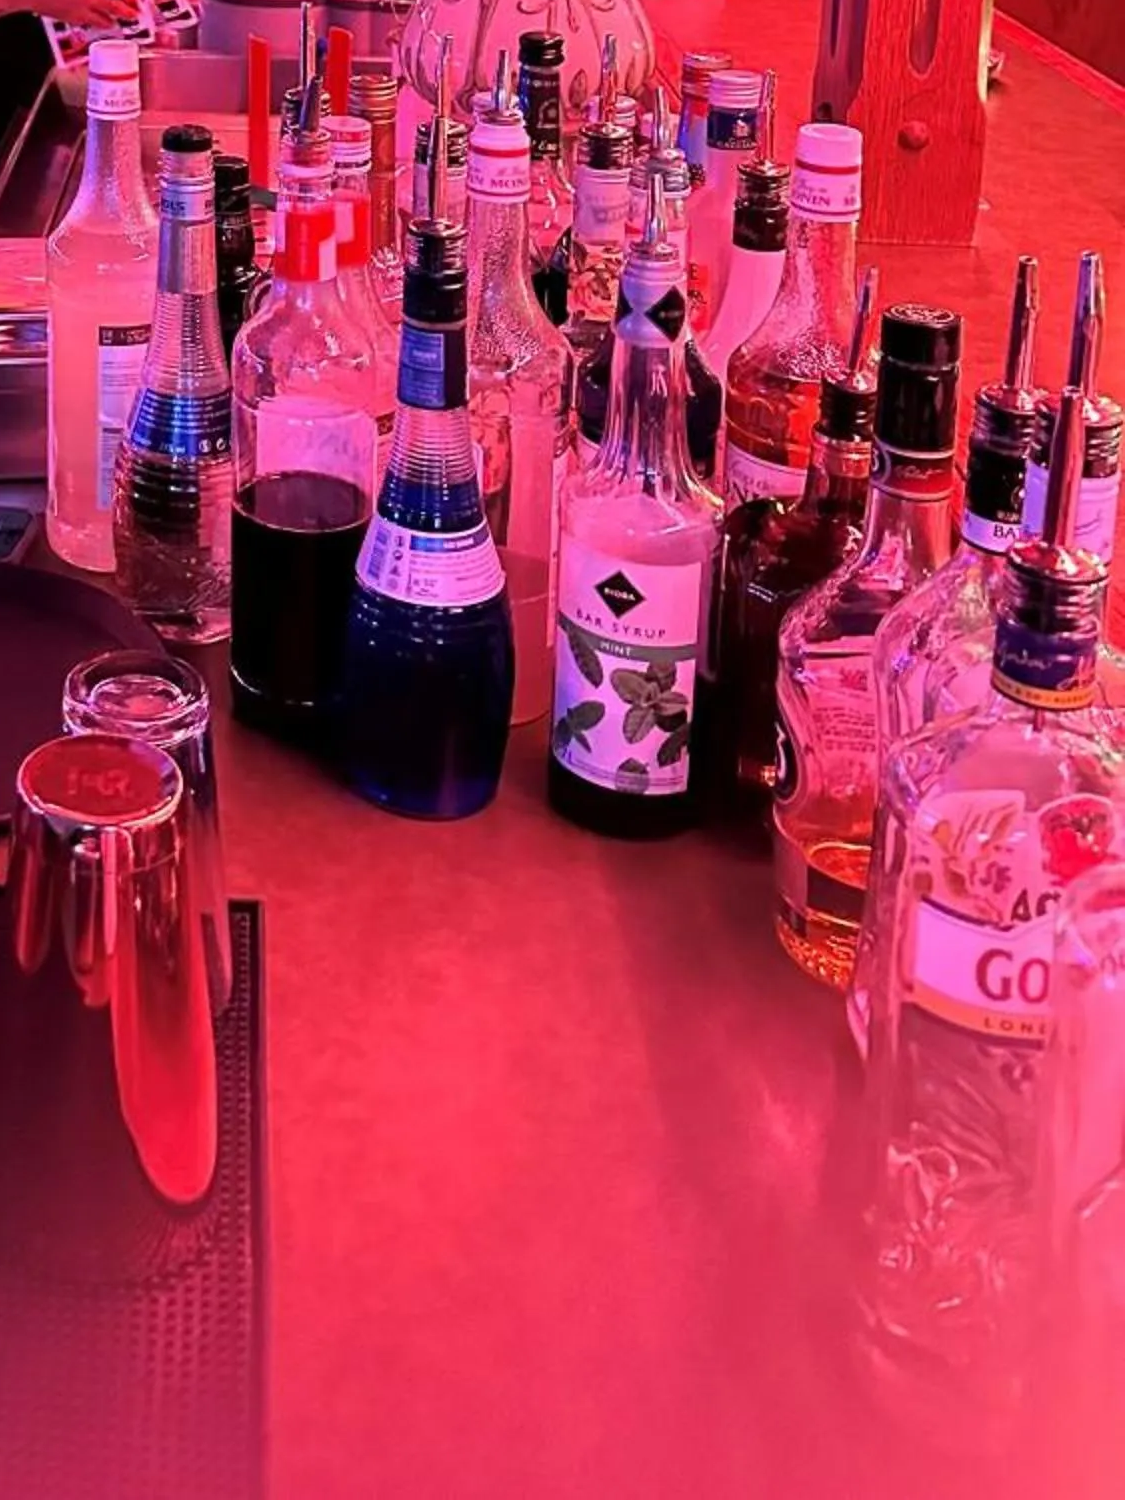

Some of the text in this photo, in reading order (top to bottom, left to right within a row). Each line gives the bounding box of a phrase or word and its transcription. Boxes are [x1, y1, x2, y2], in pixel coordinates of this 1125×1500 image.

[576, 608, 666, 639] BAR SYRUP
[600, 641, 631, 656] MINT
